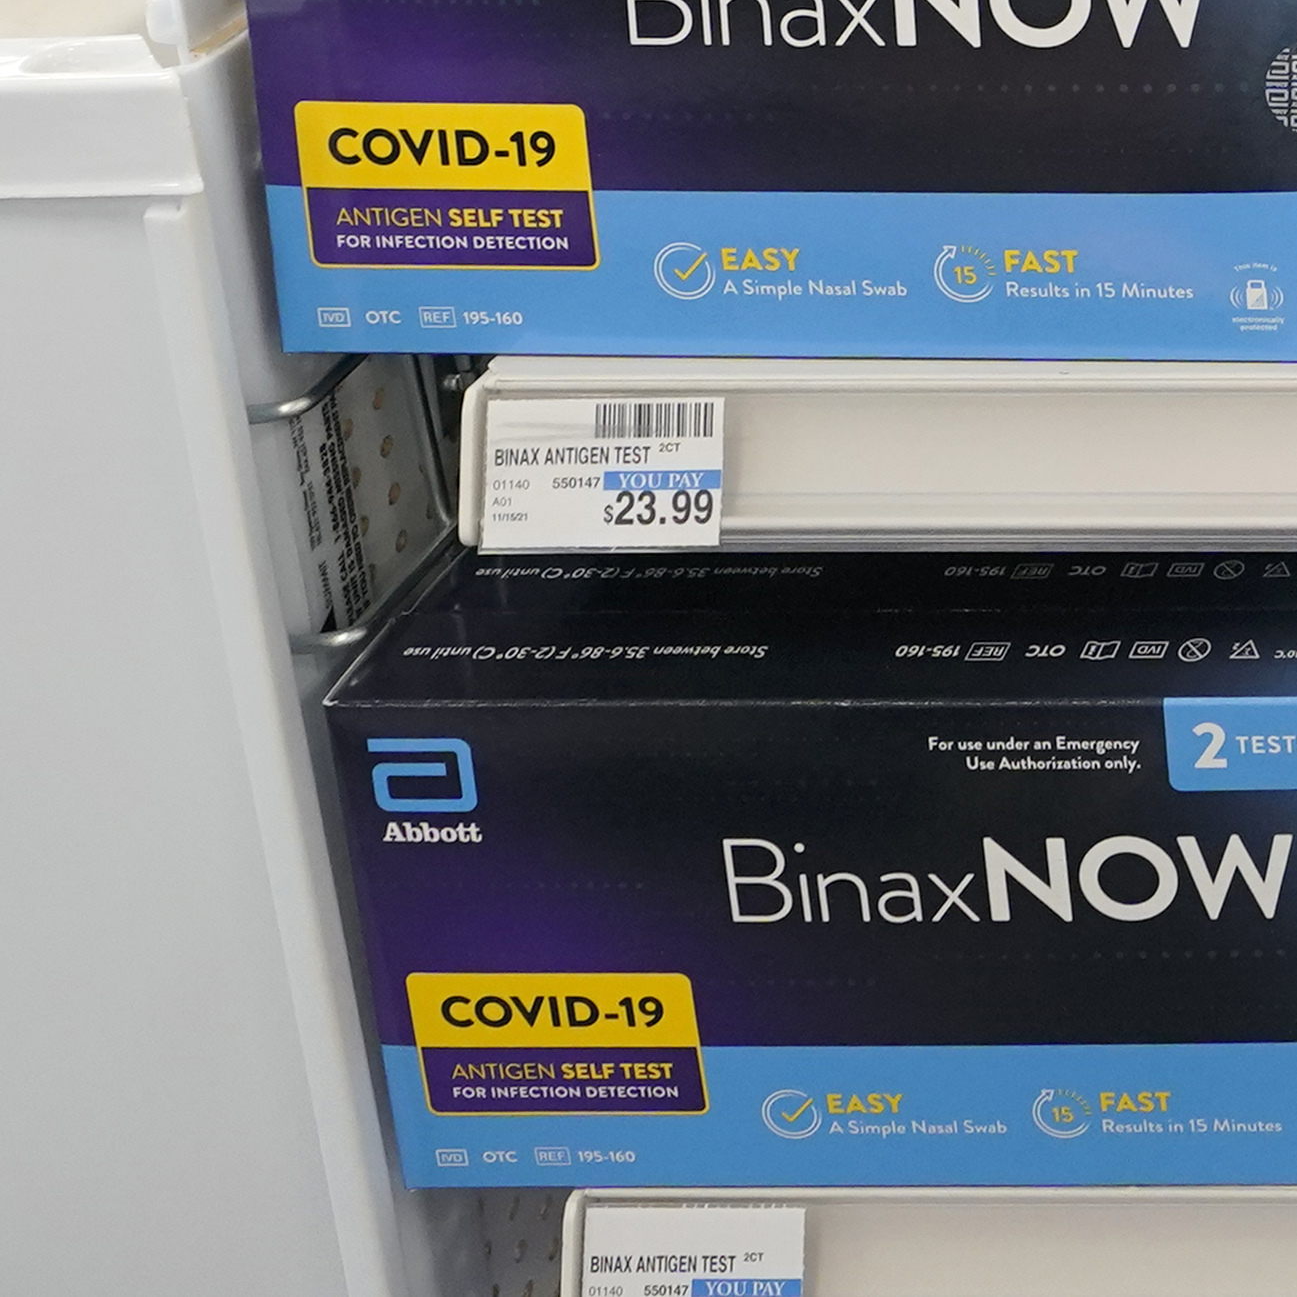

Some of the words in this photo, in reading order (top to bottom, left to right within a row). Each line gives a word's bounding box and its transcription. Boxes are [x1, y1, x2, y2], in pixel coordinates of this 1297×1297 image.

[328, 128, 556, 167] COVID-19
[336, 207, 442, 228] ANTIGEN
[448, 208, 504, 228] SELF
[509, 208, 563, 228] TEST
[337, 234, 372, 249] FOR
[376, 234, 468, 249] INFECTION
[473, 235, 569, 251] DETECTION
[721, 248, 799, 272] EASY
[1004, 250, 1078, 273] FAST
[953, 266, 977, 284] 15
[724, 280, 738, 296] A
[743, 279, 802, 301] Simple
[808, 280, 857, 297] Nasal
[862, 280, 908, 298] Swab
[1006, 282, 1069, 299] Results
[1074, 282, 1090, 299] in
[1095, 283, 1115, 299] 15
[1121, 283, 1194, 299] Minutes
[494, 449, 539, 466] BINAX
[544, 447, 609, 465] ANTIGEN
[615, 446, 650, 464] TEST
[659, 443, 681, 453] 2CT
[552, 477, 600, 489] 550147
[619, 473, 662, 488] YOU
[668, 472, 704, 488] PAY
[604, 490, 713, 526] $23.99
[404, 647, 426, 657] use
[1192, 723, 1227, 768] 2
[383, 821, 483, 843] Abbott
[441, 996, 664, 1027] COVID-19
[453, 1063, 555, 1081] ANTIGEN
[561, 1063, 615, 1080] SELF
[620, 1063, 672, 1079] TEST
[827, 1094, 903, 1114] EASY
[1099, 1092, 1171, 1112] FAST
[591, 1256, 632, 1273] BINAX
[636, 1256, 697, 1273] ANTIGEN
[702, 1256, 736, 1272] TEST
[744, 1253, 763, 1262] 2CT
[644, 1285, 689, 1296] 550147
[706, 1281, 747, 1296] YOU
[753, 1281, 785, 1296] PAY
